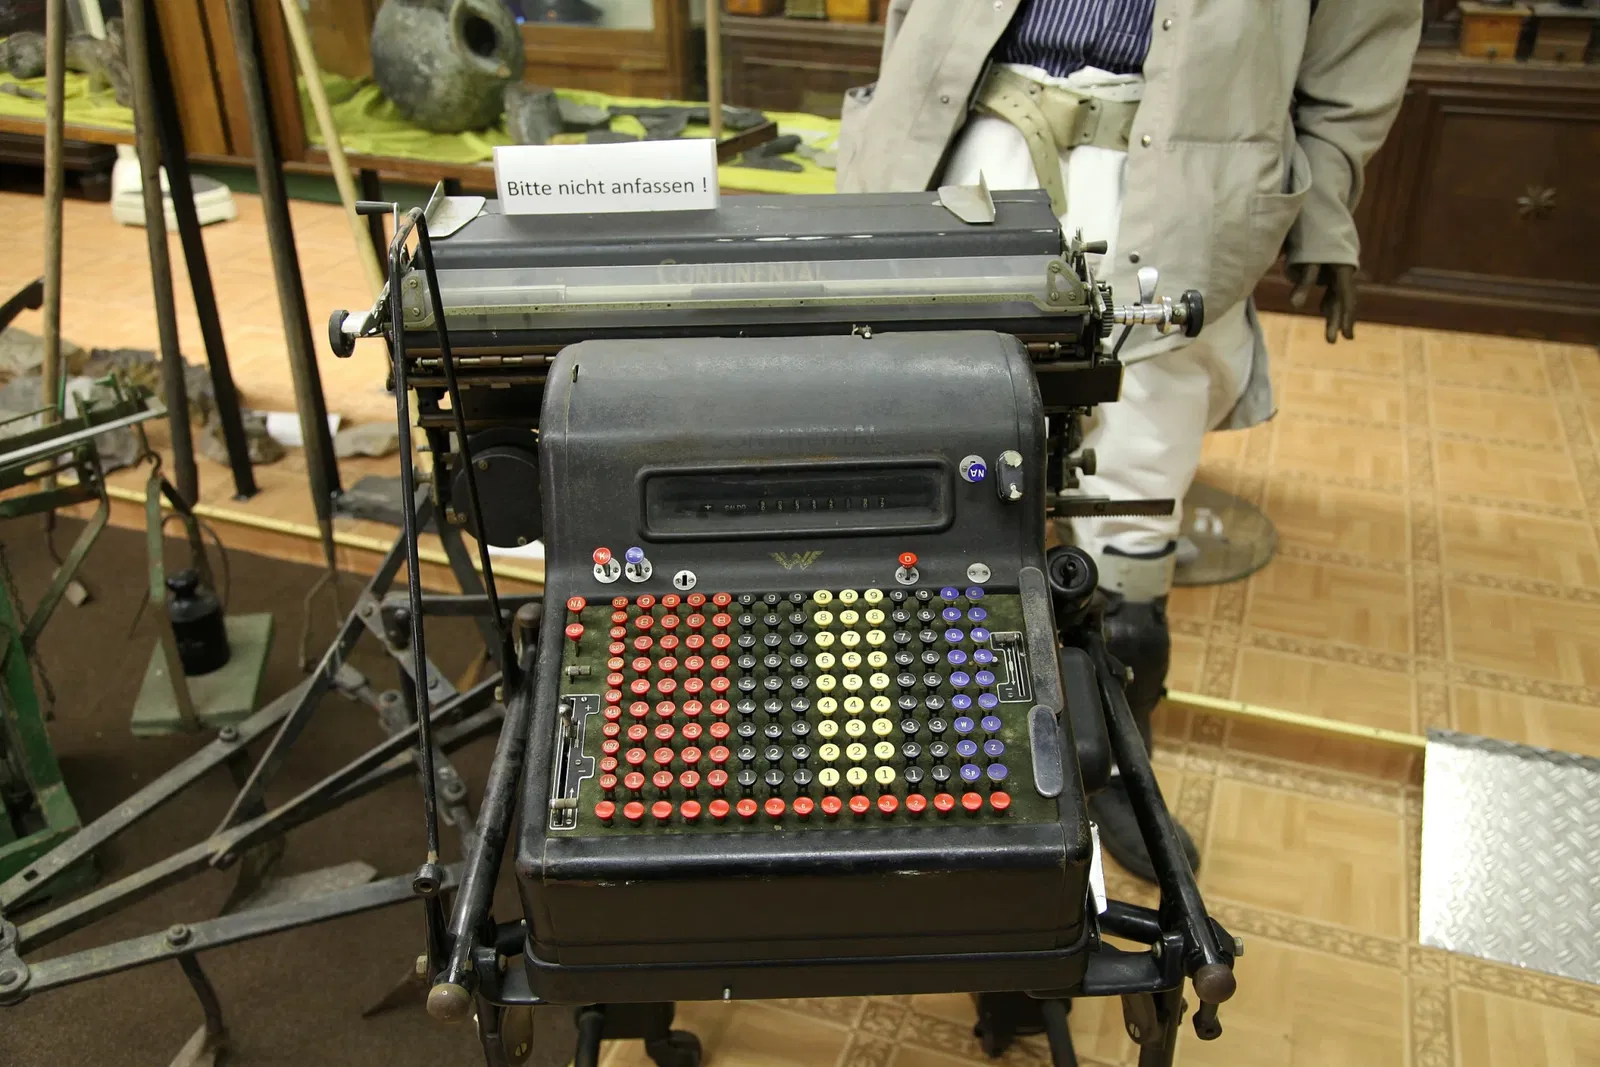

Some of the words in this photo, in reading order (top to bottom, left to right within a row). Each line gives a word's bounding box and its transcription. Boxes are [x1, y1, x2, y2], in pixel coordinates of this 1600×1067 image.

[507, 181, 552, 196] Bitte
[558, 179, 604, 194] nicht
[612, 178, 694, 194] anfassen
[702, 177, 707, 192] !
[657, 259, 827, 284] CONTINENTAL
